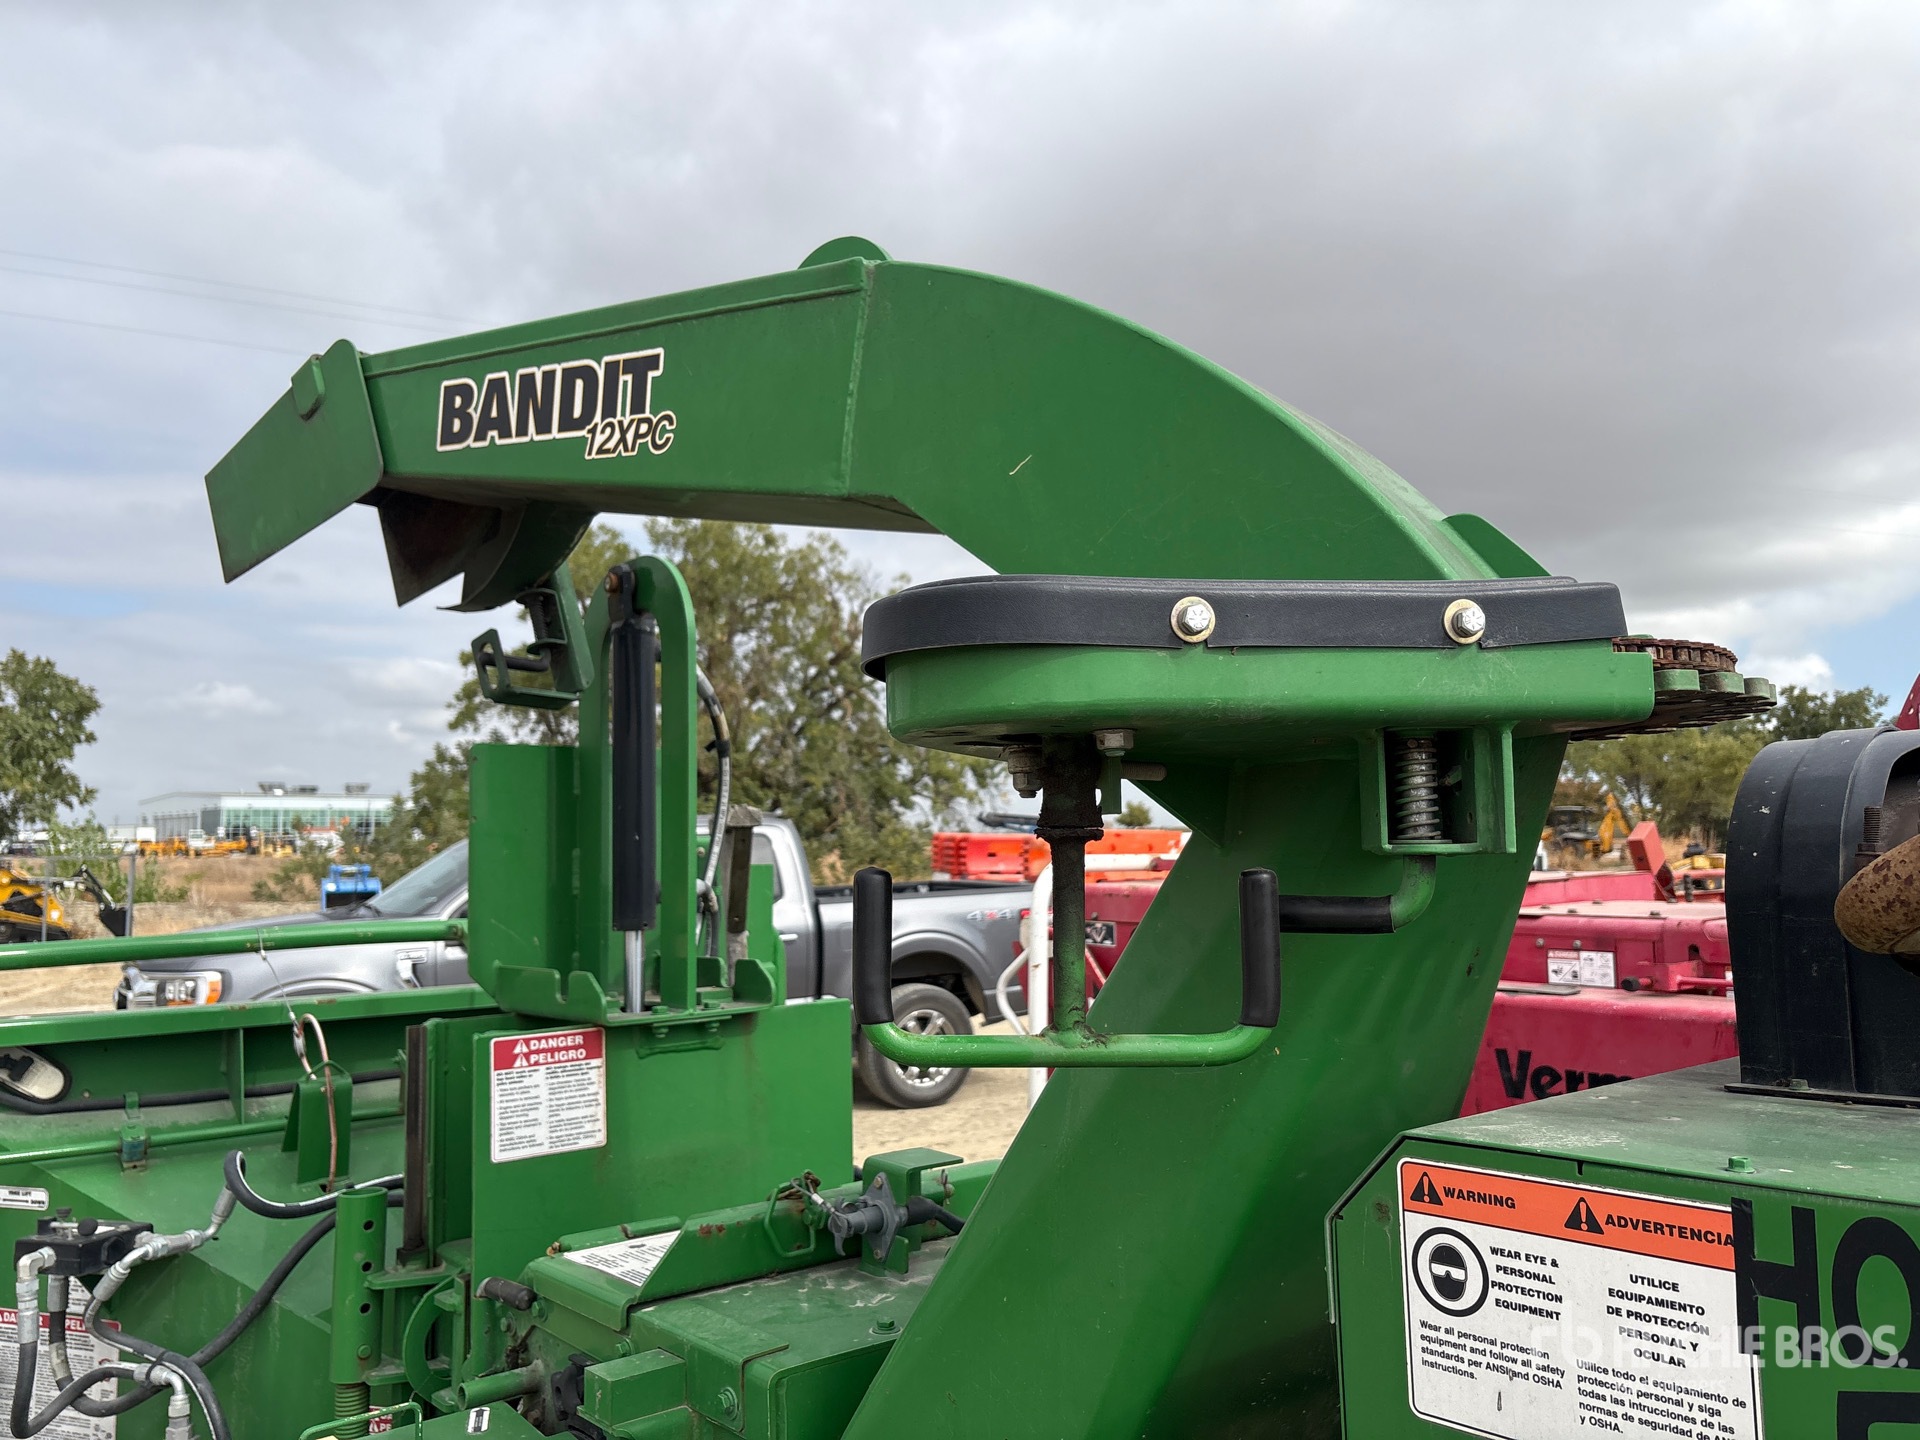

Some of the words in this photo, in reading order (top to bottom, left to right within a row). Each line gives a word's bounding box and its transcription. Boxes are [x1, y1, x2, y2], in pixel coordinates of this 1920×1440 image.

[437, 349, 664, 450] BANDIT
[585, 411, 675, 459] 12XPC
[529, 1034, 584, 1050] DANGER
[529, 1048, 586, 1065] PELIGRO
[1443, 1186, 1516, 1209] WARNING
[1605, 1214, 1734, 1247] ADVERTENCIA
[1490, 1246, 1521, 1260] WEAR
[1524, 1252, 1547, 1266] EYE
[1550, 1258, 1559, 1268] &
[1496, 1264, 1556, 1285] PERSONAL
[1630, 1274, 1680, 1292] UTILICE
[1490, 1280, 1562, 1304] PROTECTION
[1608, 1287, 1705, 1316] EQUIPAMIENTO
[1495, 1298, 1561, 1321] EQUIPMENT
[1606, 1305, 1622, 1318] DE
[1626, 1310, 1710, 1336] PROTECCIÓN
[1420, 1319, 1441, 1332] Wear
[1444, 1326, 1454, 1336] all
[1458, 1330, 1497, 1346] personal
[1500, 1340, 1550, 1360] protection
[1618, 1326, 1686, 1350] PERSONAL
[1689, 1342, 1698, 1352] Y
[1420, 1333, 1466, 1352] equipment
[1470, 1344, 1486, 1358] and
[1489, 1350, 1518, 1364] follow
[1521, 1358, 1532, 1368] all
[1536, 1363, 1565, 1379] safety
[1420, 1346, 1464, 1364] standards
[1468, 1358, 1482, 1371] per
[1486, 1362, 1508, 1376] ANSI
[1512, 1370, 1529, 1381] and
[1532, 1374, 1562, 1390] OSHA
[1422, 1356, 1478, 1380] instructions.
[1634, 1348, 1686, 1368] OCULAR
[1576, 1358, 1609, 1376] Utilice
[1612, 1368, 1636, 1382] todo
[1640, 1375, 1649, 1386] el
[1652, 1379, 1728, 1404] equipamiento
[1732, 1396, 1746, 1409] de
[1577, 1374, 1633, 1396] protección
[1636, 1388, 1684, 1408] personal
[1688, 1402, 1694, 1412] y
[1698, 1403, 1722, 1418] siga
[1578, 1386, 1607, 1402] todas
[1610, 1393, 1626, 1407] las
[1629, 1397, 1697, 1425] intrucciones
[1700, 1417, 1715, 1430] de
[1718, 1422, 1734, 1435] las
[1579, 1402, 1618, 1419] normas
[1622, 1411, 1634, 1423] de
[1638, 1418, 1692, 1439] seguridad
[1696, 1430, 1710, 1440] de
[1579, 1415, 1586, 1425] y
[1589, 1416, 1624, 1434] OSHA.
